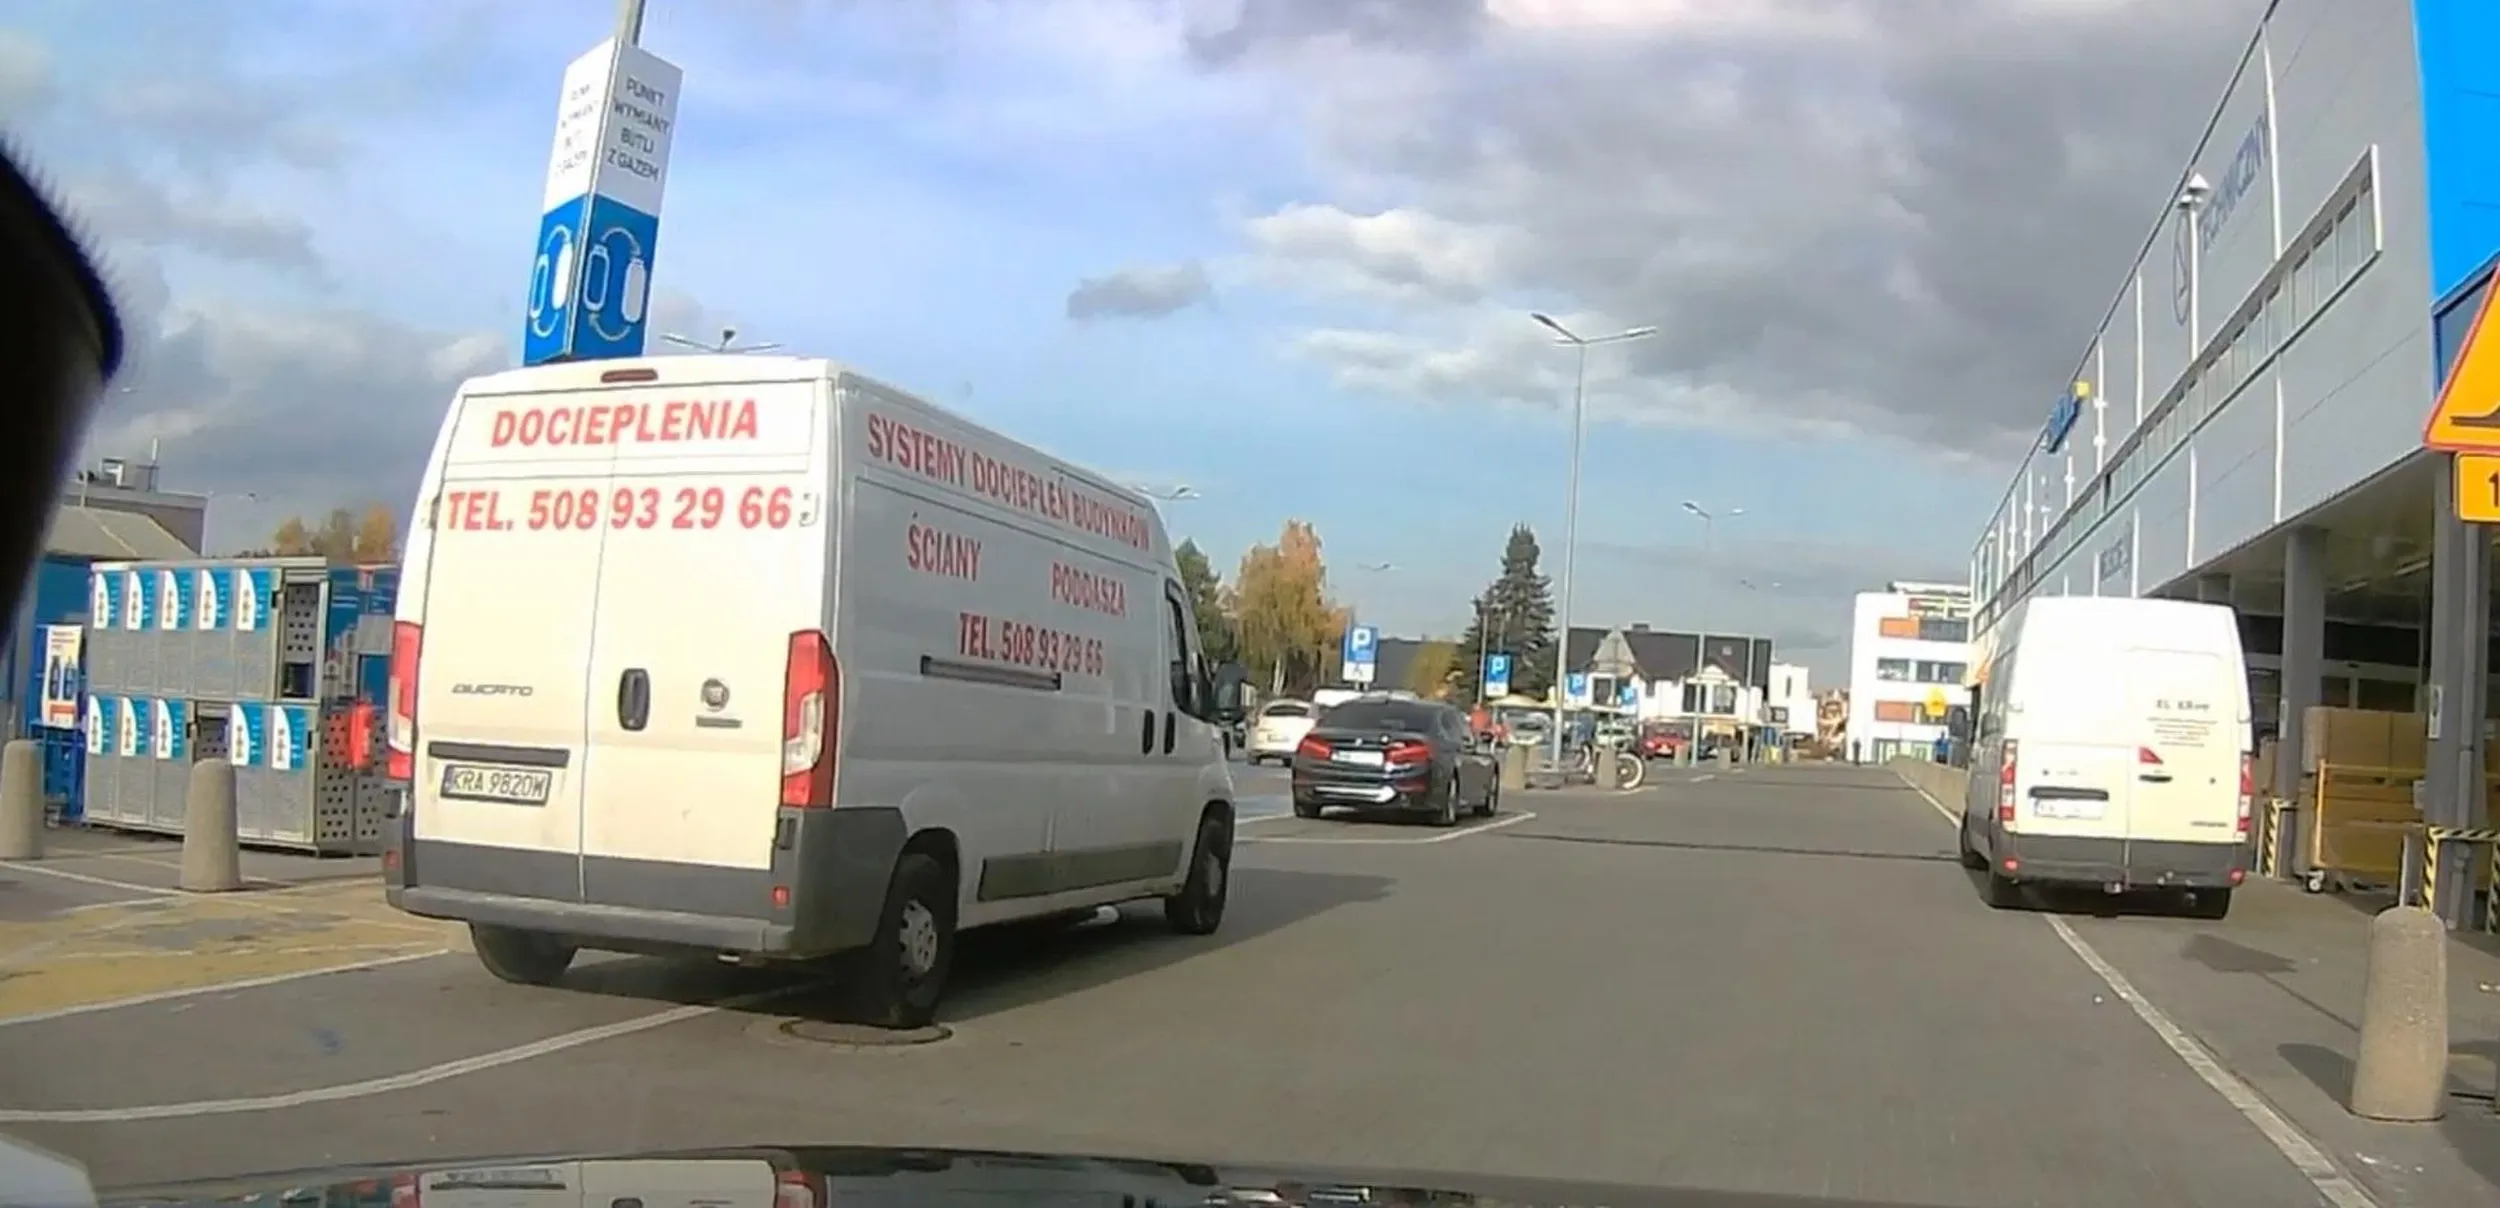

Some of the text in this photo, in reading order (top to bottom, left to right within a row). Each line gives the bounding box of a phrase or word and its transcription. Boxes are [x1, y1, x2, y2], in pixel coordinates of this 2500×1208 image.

[626, 77, 665, 106] PUNKT
[613, 97, 670, 135] WYMIANY
[621, 127, 655, 154] BUTLI
[608, 148, 660, 182] Z GAZEM
[490, 399, 759, 448] DOCIEPLENIA
[867, 413, 1150, 552] SYSTEMY DOCIEPLEŃ BUDYNKÓW
[446, 486, 793, 531] TEL. 508 93 29 66
[907, 511, 1126, 618] ŚCIANY PODDASZA
[959, 612, 1104, 677] TEL. 508 93 29 66
[1353, 627, 1372, 651] P
[1491, 656, 1505, 676] P
[452, 683, 534, 697] DUCATO
[454, 770, 484, 792] KRA
